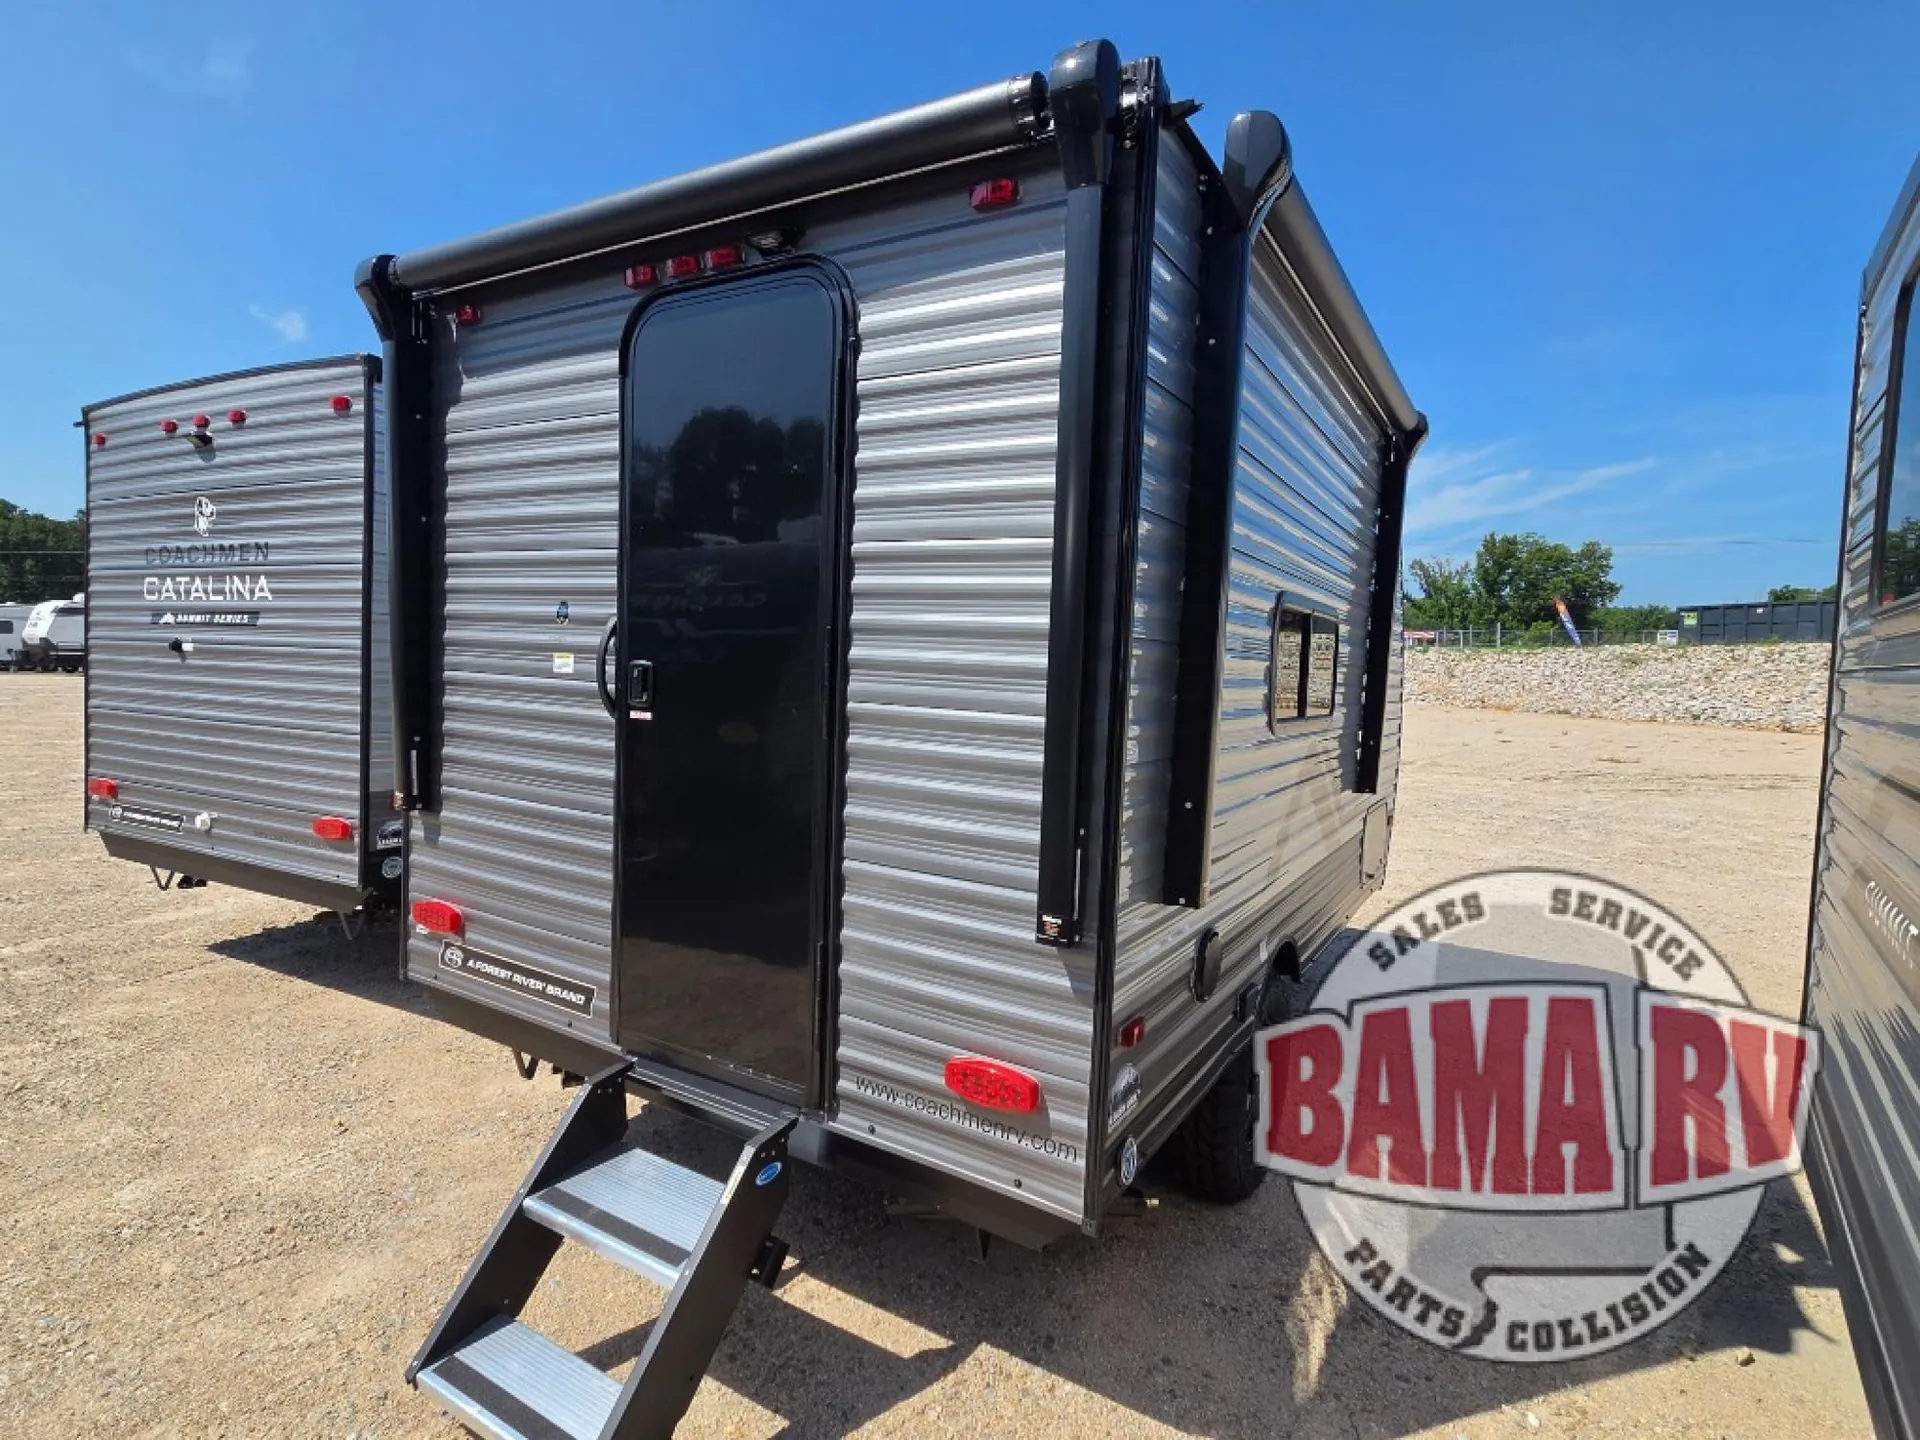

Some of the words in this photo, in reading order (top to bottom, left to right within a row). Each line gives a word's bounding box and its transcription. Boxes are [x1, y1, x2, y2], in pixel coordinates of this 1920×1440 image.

[145, 541, 269, 565] COACHMEN
[143, 574, 273, 601] CATALINA
[466, 959, 475, 968] A
[475, 961, 512, 980] FOREST
[546, 983, 585, 1005] BRAND
[855, 1074, 1078, 1164] www.coachmenrv.com
